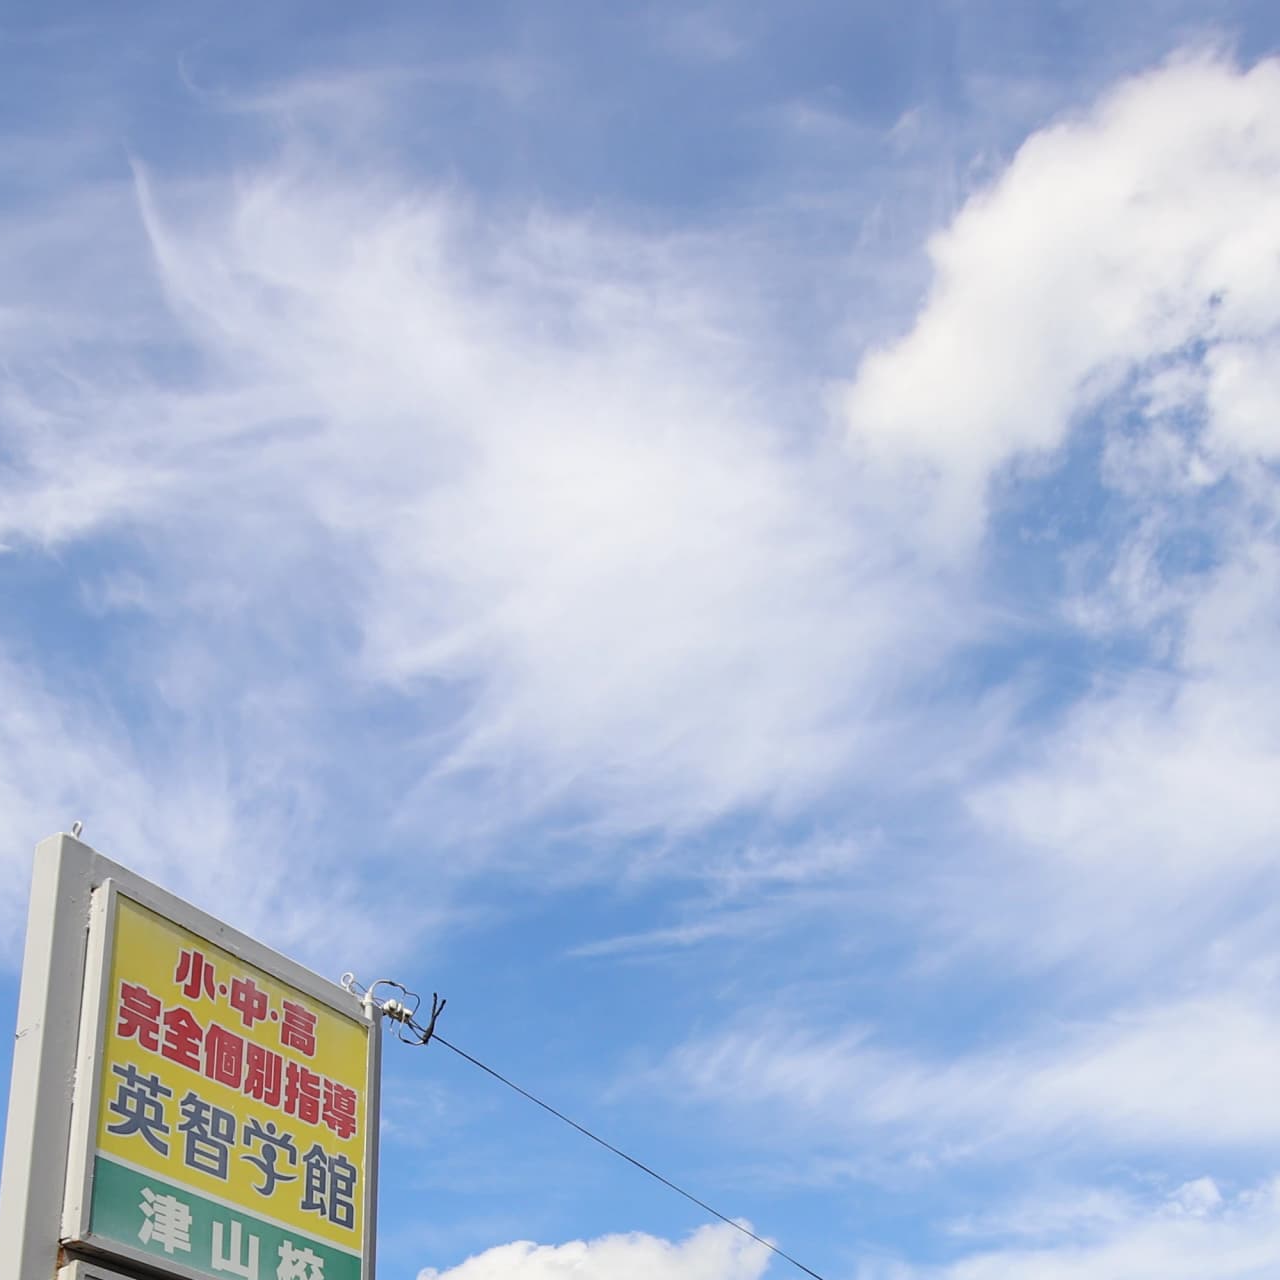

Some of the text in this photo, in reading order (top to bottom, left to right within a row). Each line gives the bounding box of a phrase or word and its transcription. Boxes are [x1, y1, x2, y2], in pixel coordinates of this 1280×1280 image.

[116, 982, 358, 1140] 完全個別指導
[176, 949, 318, 1057] 小・中・高
[107, 1063, 358, 1230] 英智学館
